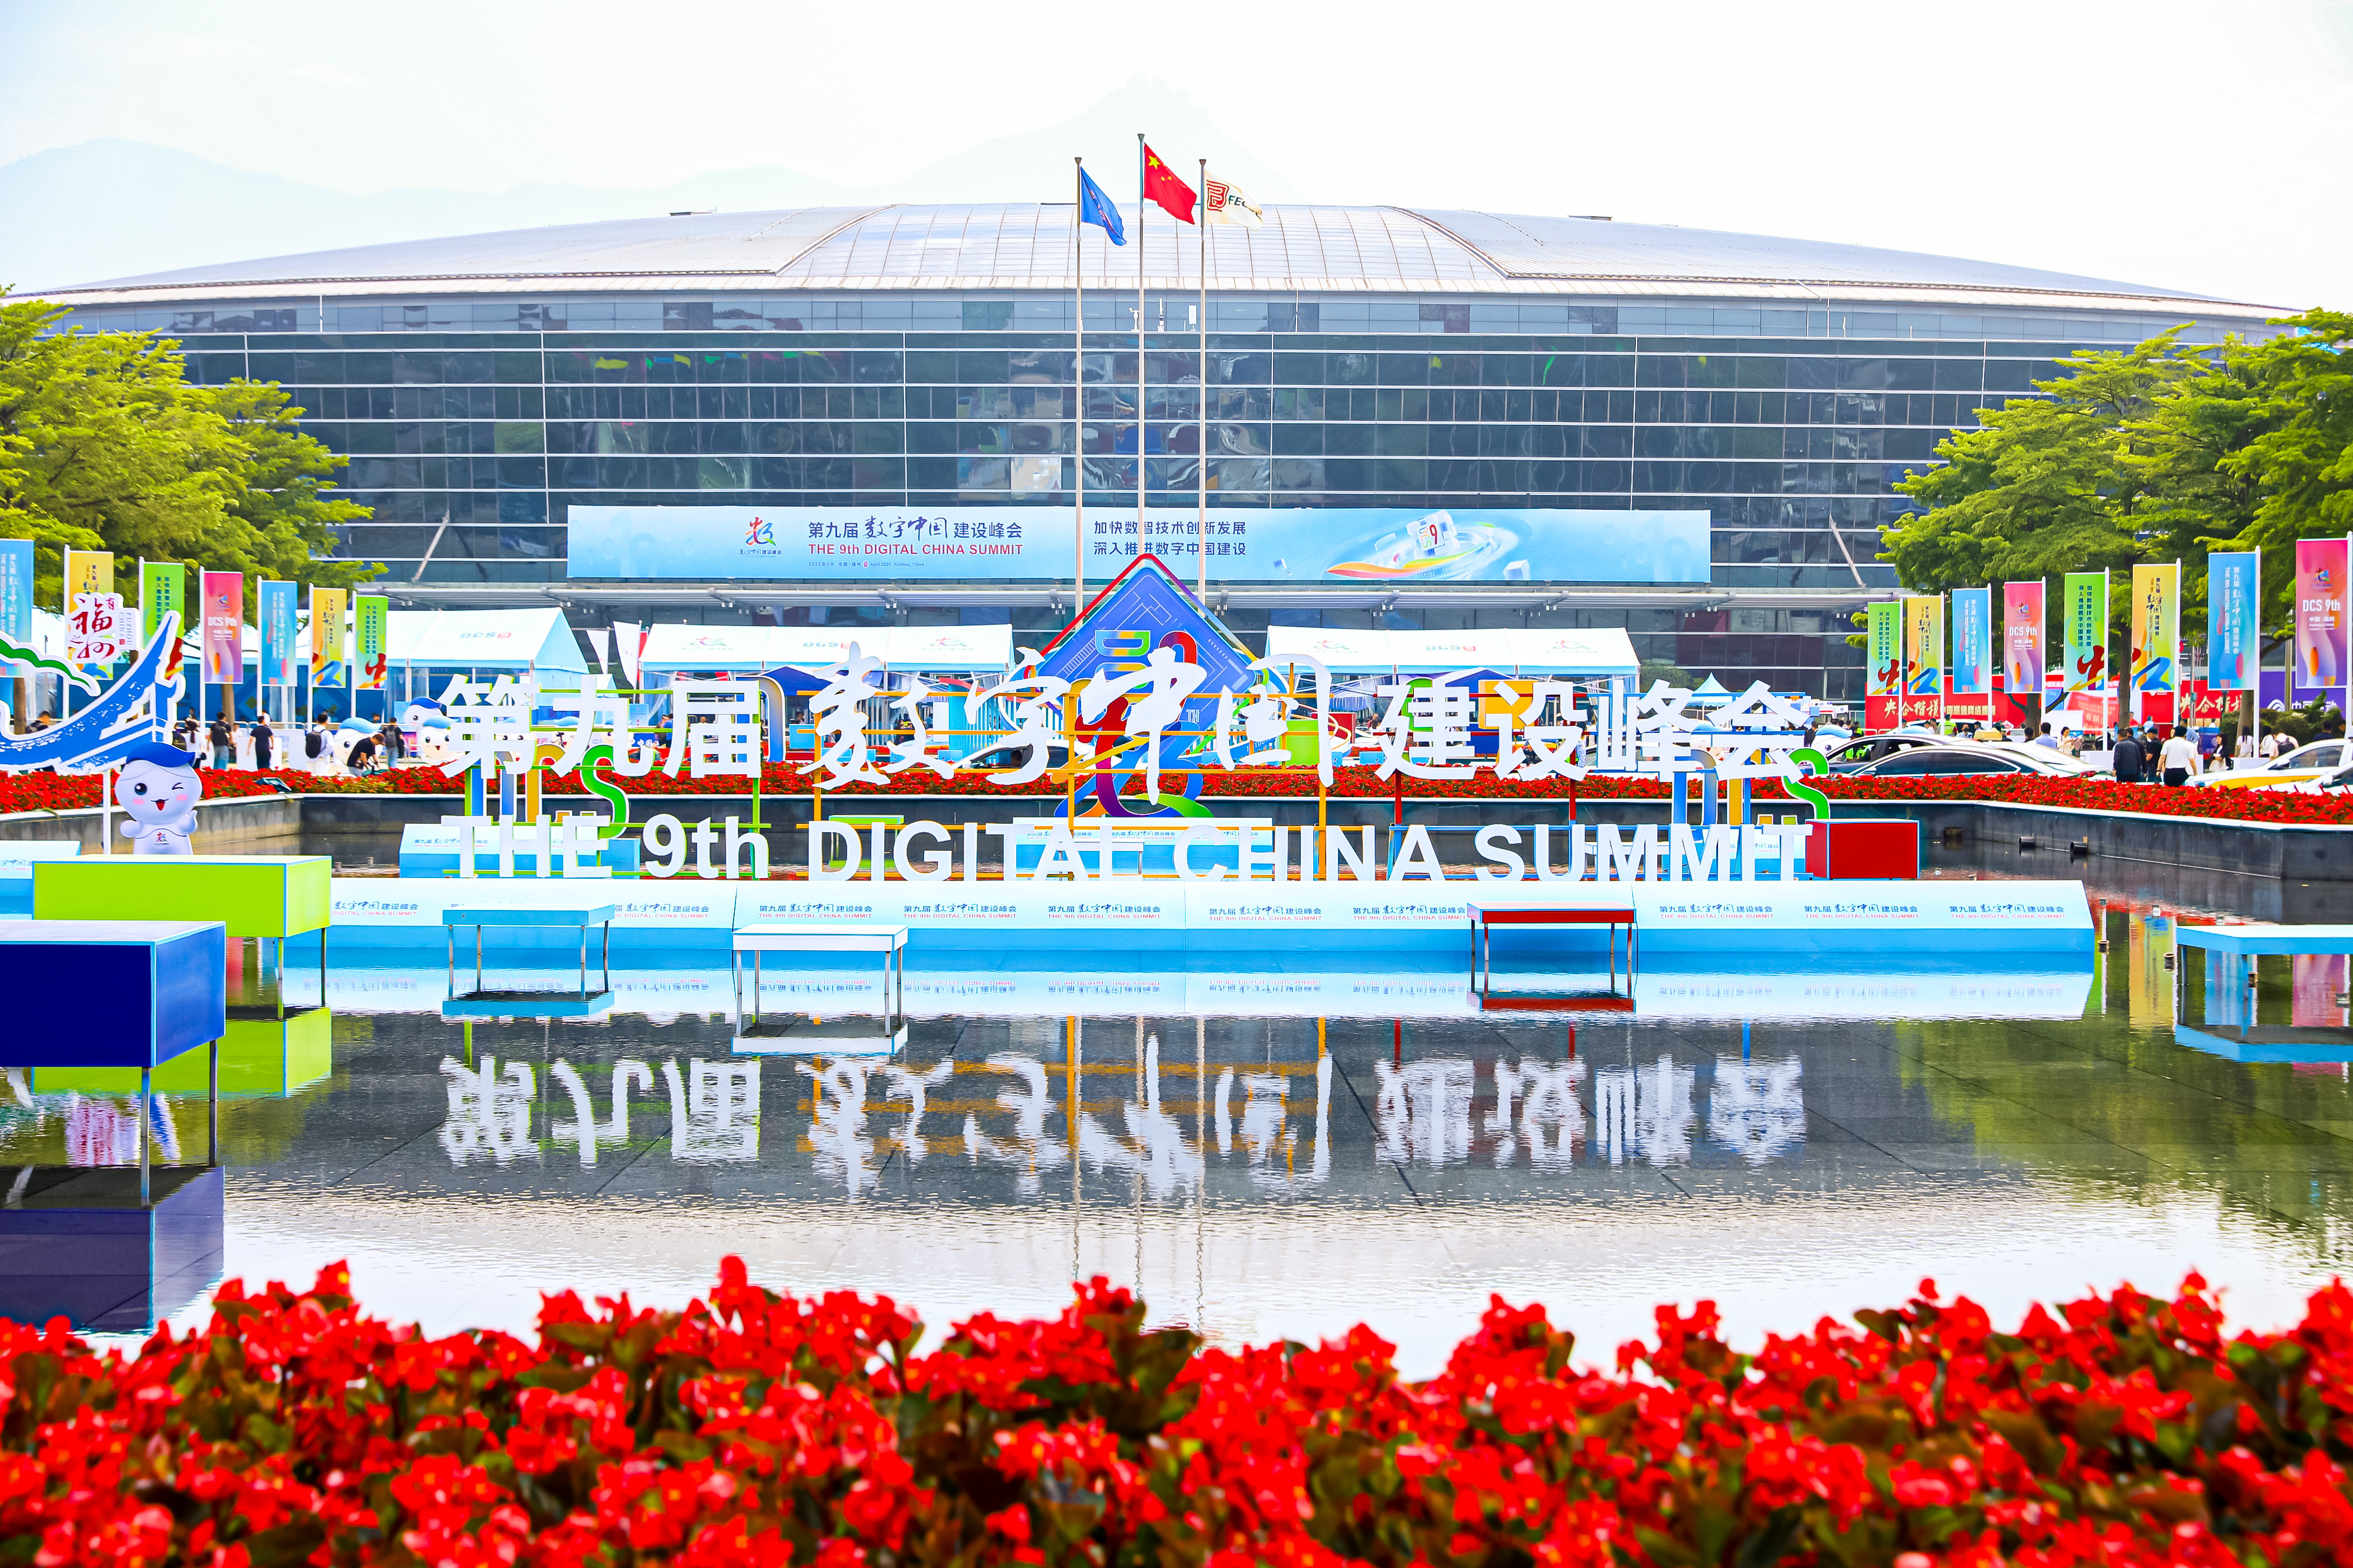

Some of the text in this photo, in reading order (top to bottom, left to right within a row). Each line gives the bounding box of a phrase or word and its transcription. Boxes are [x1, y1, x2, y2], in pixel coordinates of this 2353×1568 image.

[1094, 521, 1246, 535] 加快数智技术创新发展
[809, 544, 1023, 554] THE 9th DIGITAL CHINA SUMMIT
[1094, 541, 1246, 556] 深入推进数字中国建设
[2302, 599, 2341, 612] DCS 9th
[2009, 626, 2037, 636] DCS 9th
[441, 814, 1813, 881] THE 9th DIGITAL CHINA SUMMIT
